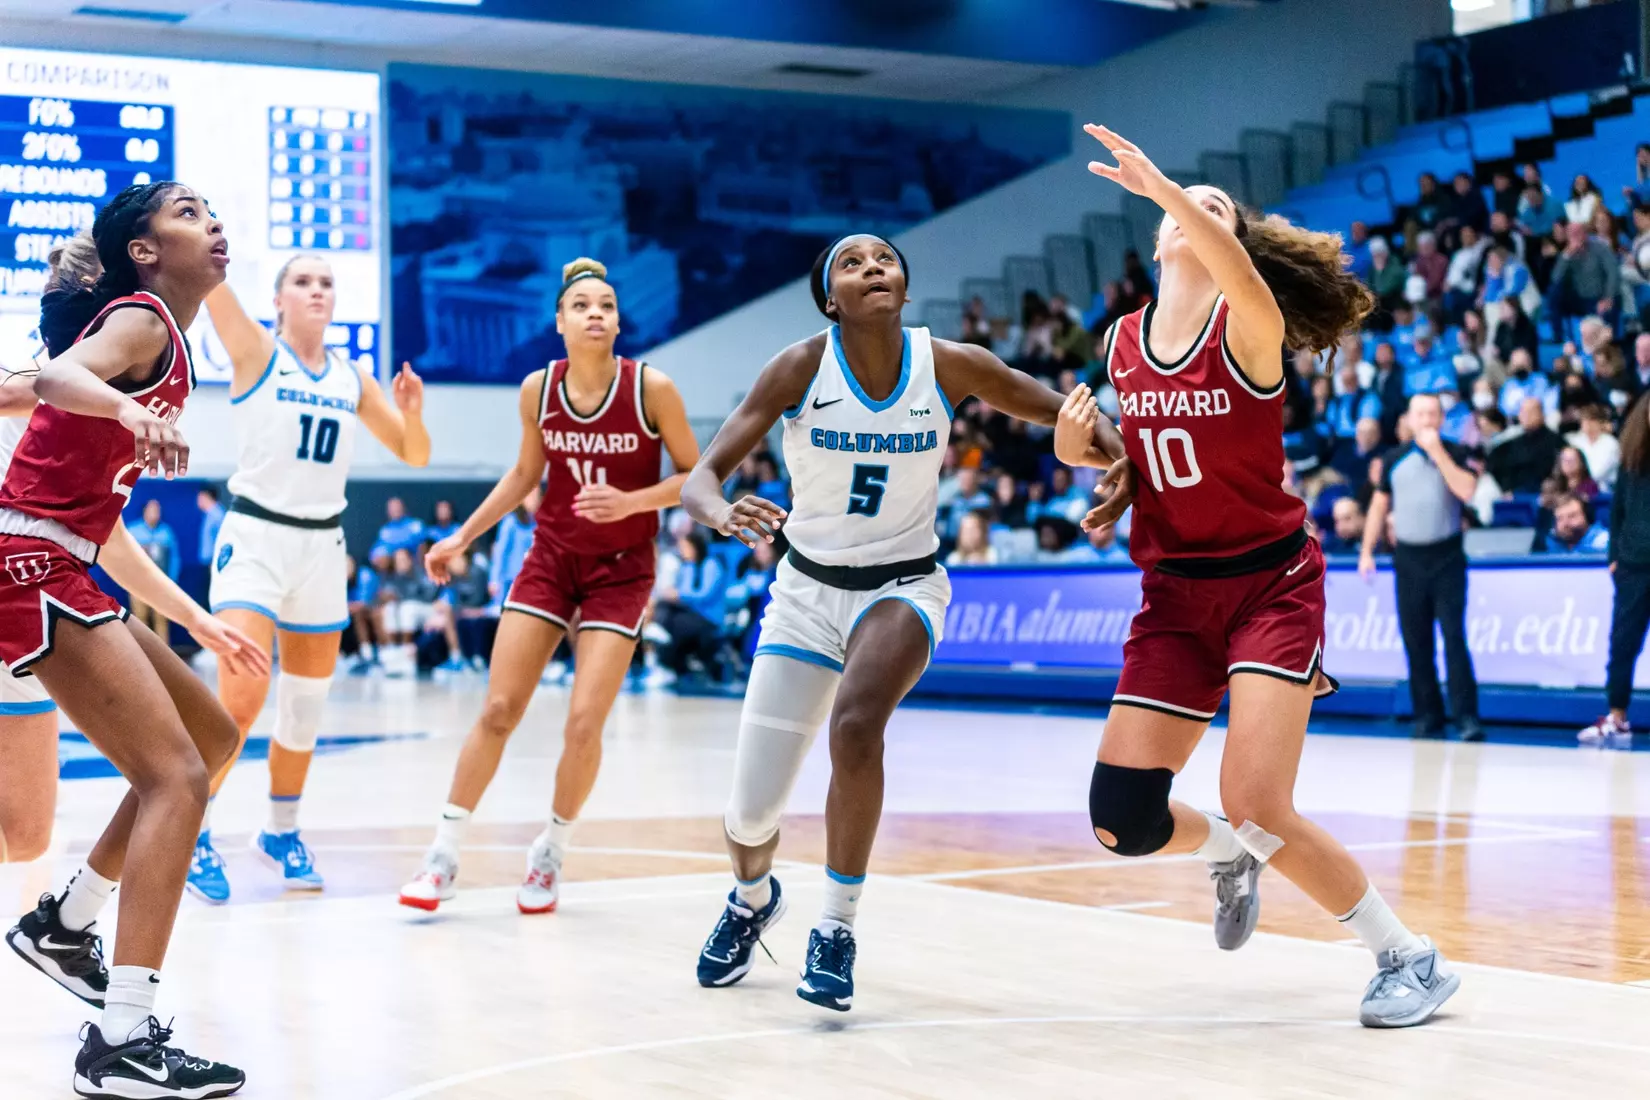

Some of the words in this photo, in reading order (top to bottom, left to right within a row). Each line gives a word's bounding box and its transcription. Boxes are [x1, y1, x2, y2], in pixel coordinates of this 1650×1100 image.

[7, 62, 171, 91] COMPARISON
[909, 408, 924, 418] Ivy
[296, 413, 340, 464] 10
[541, 428, 639, 454] HARVARD
[810, 427, 938, 453] COLUMBIA
[1138, 427, 1203, 492] 10
[846, 463, 890, 517] 5
